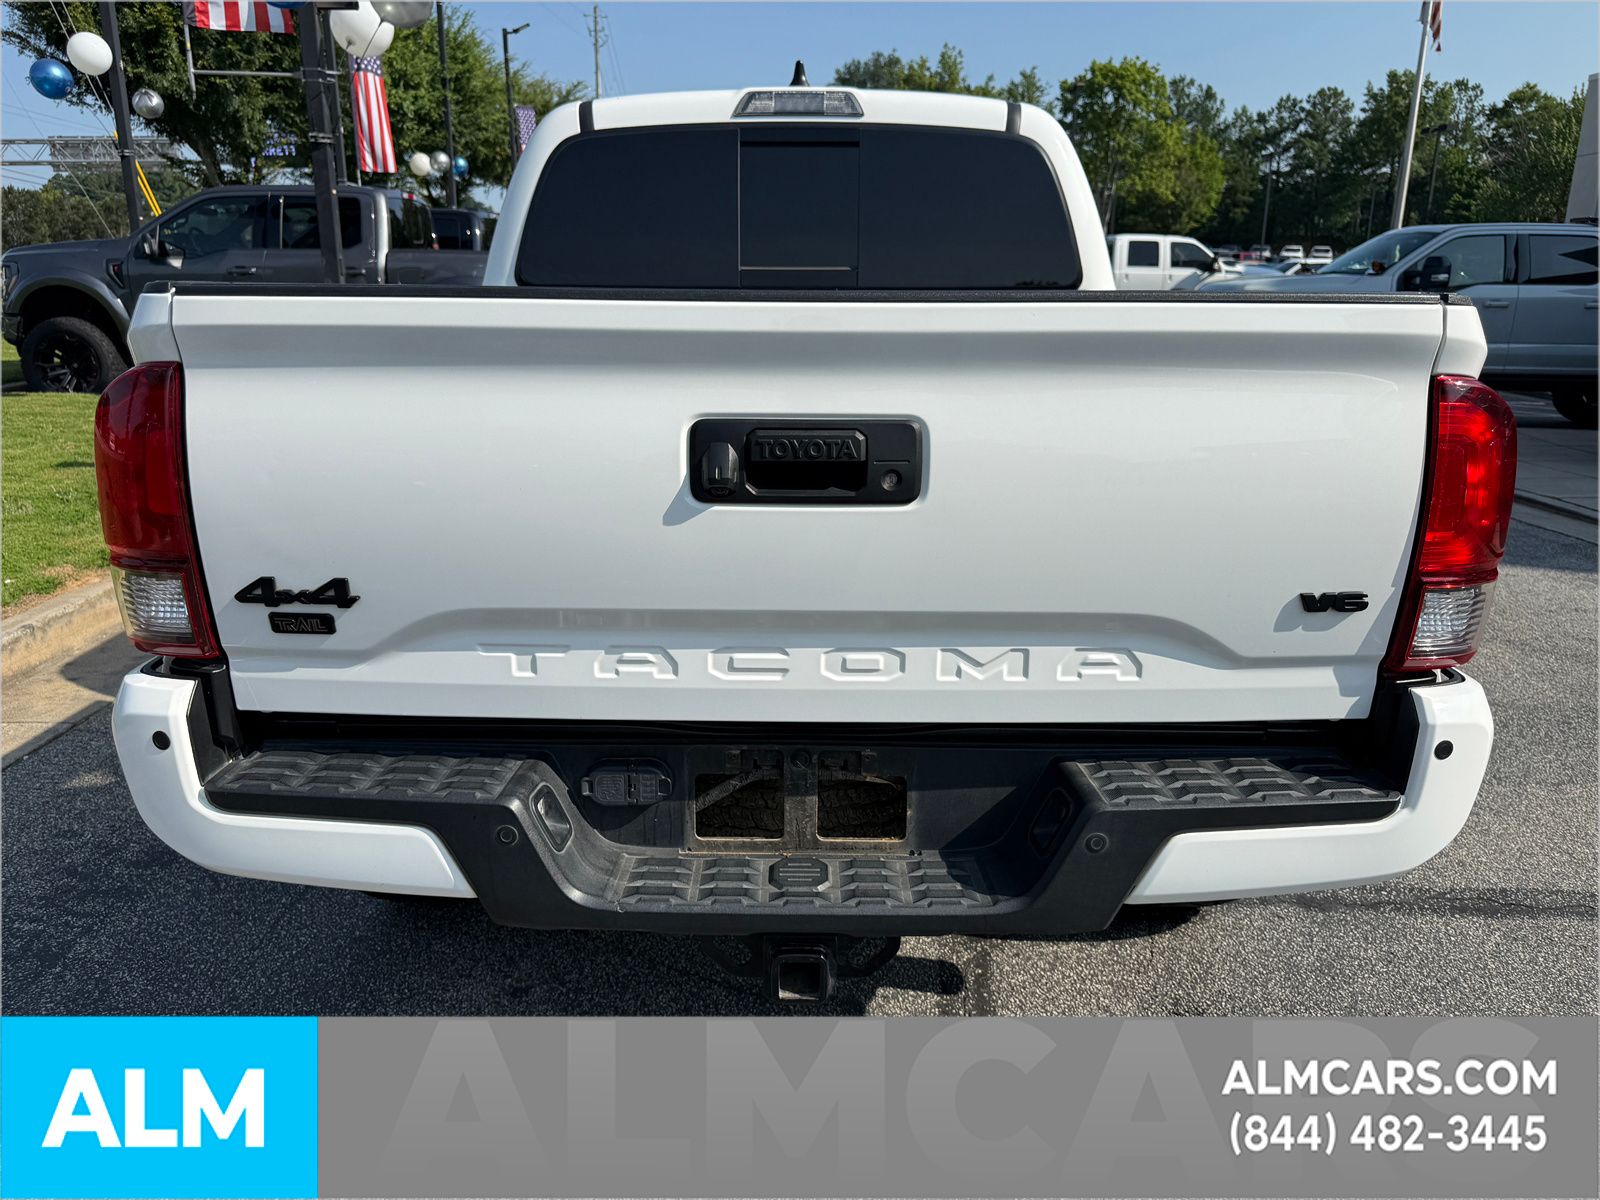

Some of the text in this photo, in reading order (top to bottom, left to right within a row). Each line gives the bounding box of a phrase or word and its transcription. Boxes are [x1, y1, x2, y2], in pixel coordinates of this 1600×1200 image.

[755, 438, 858, 459] TOYOTA
[1299, 591, 1369, 613] V6
[274, 617, 329, 632] TRAIL
[476, 643, 1143, 683] TACOMA
